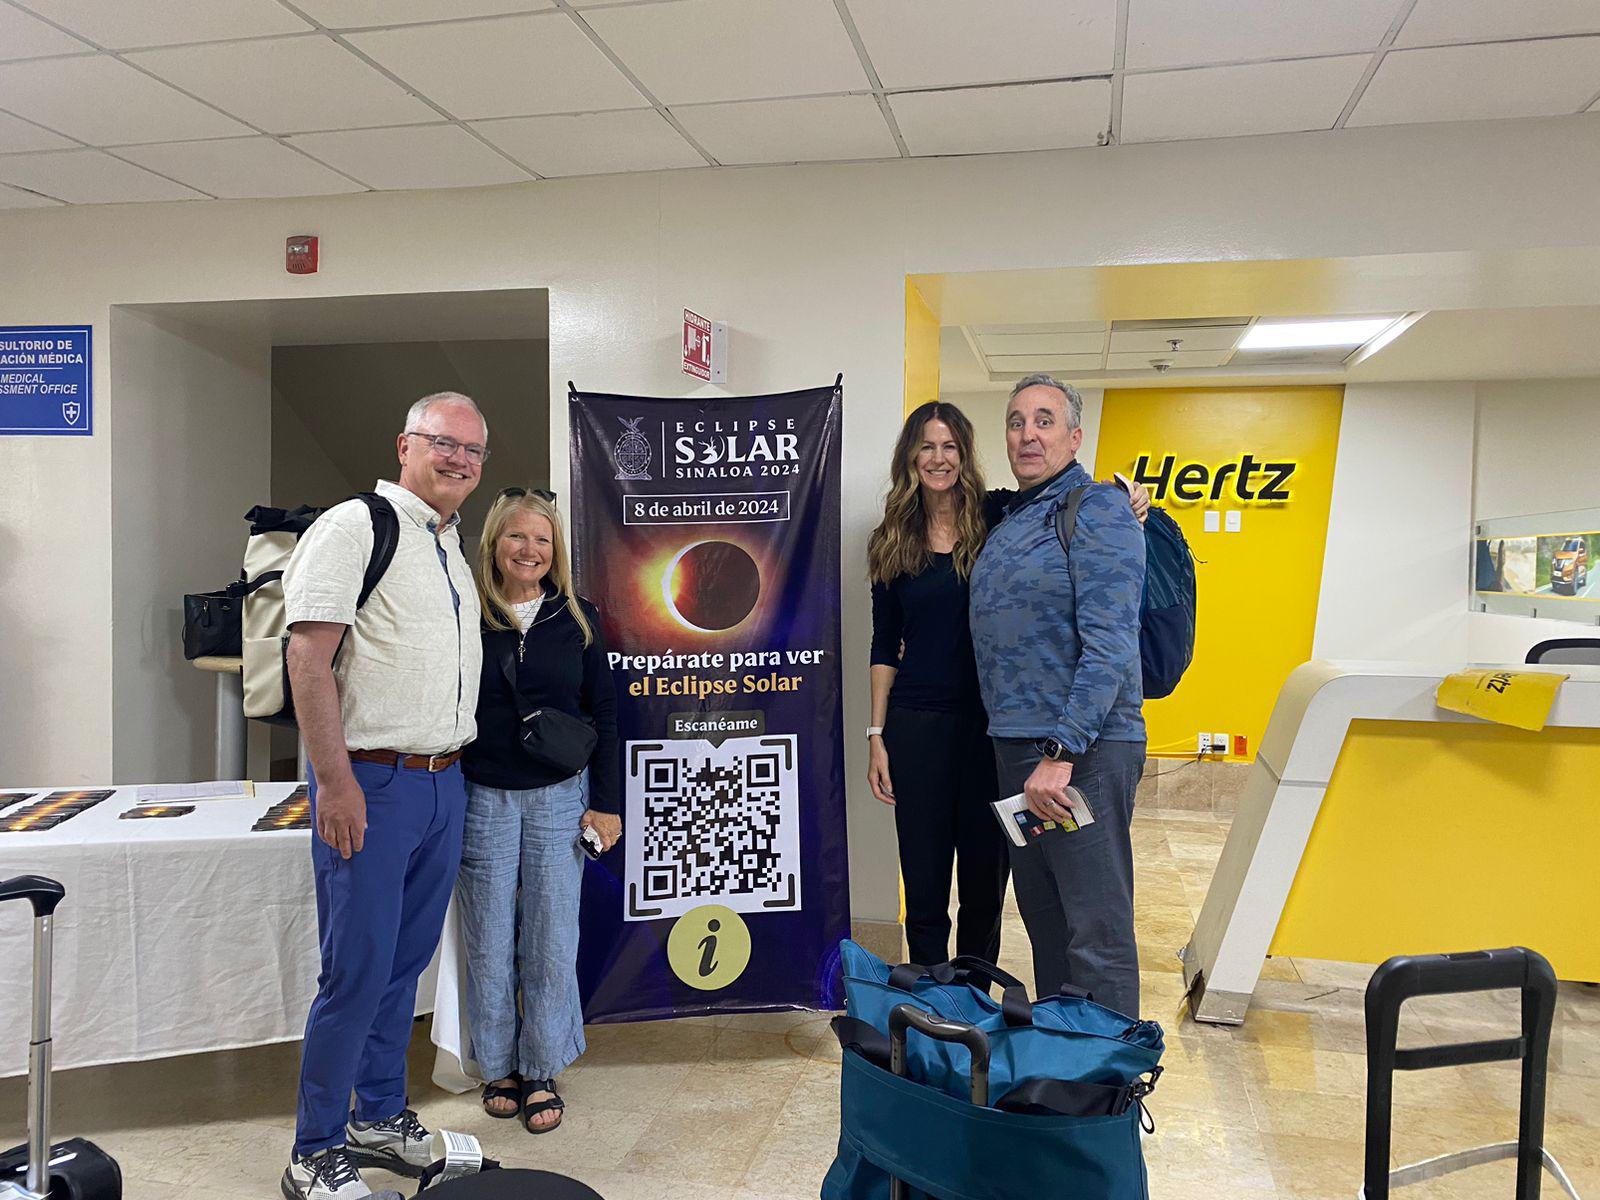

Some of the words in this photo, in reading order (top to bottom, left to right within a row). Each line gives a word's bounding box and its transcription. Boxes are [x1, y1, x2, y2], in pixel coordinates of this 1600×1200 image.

[57, 340, 72, 350] DE
[38, 352, 83, 364] MÉDICA
[0, 373, 45, 383] MEDICAL
[40, 384, 78, 394] OFFICE
[676, 418, 795, 433] ECLIPSE
[675, 434, 800, 465] SOLAR
[675, 465, 753, 479] SINALOA
[760, 464, 800, 477] 2024
[1135, 455, 1297, 500] Hertz
[634, 503, 644, 517] 8
[649, 501, 669, 516] de
[672, 500, 711, 516] abril
[715, 500, 735, 515] de
[738, 499, 779, 515] 2024
[606, 648, 724, 675] Prepárate
[729, 650, 781, 672] para
[786, 649, 824, 665] ver
[629, 676, 650, 697] el
[656, 674, 738, 700] Eclipse
[742, 672, 802, 694] Solar
[674, 718, 758, 732] Escanéame
